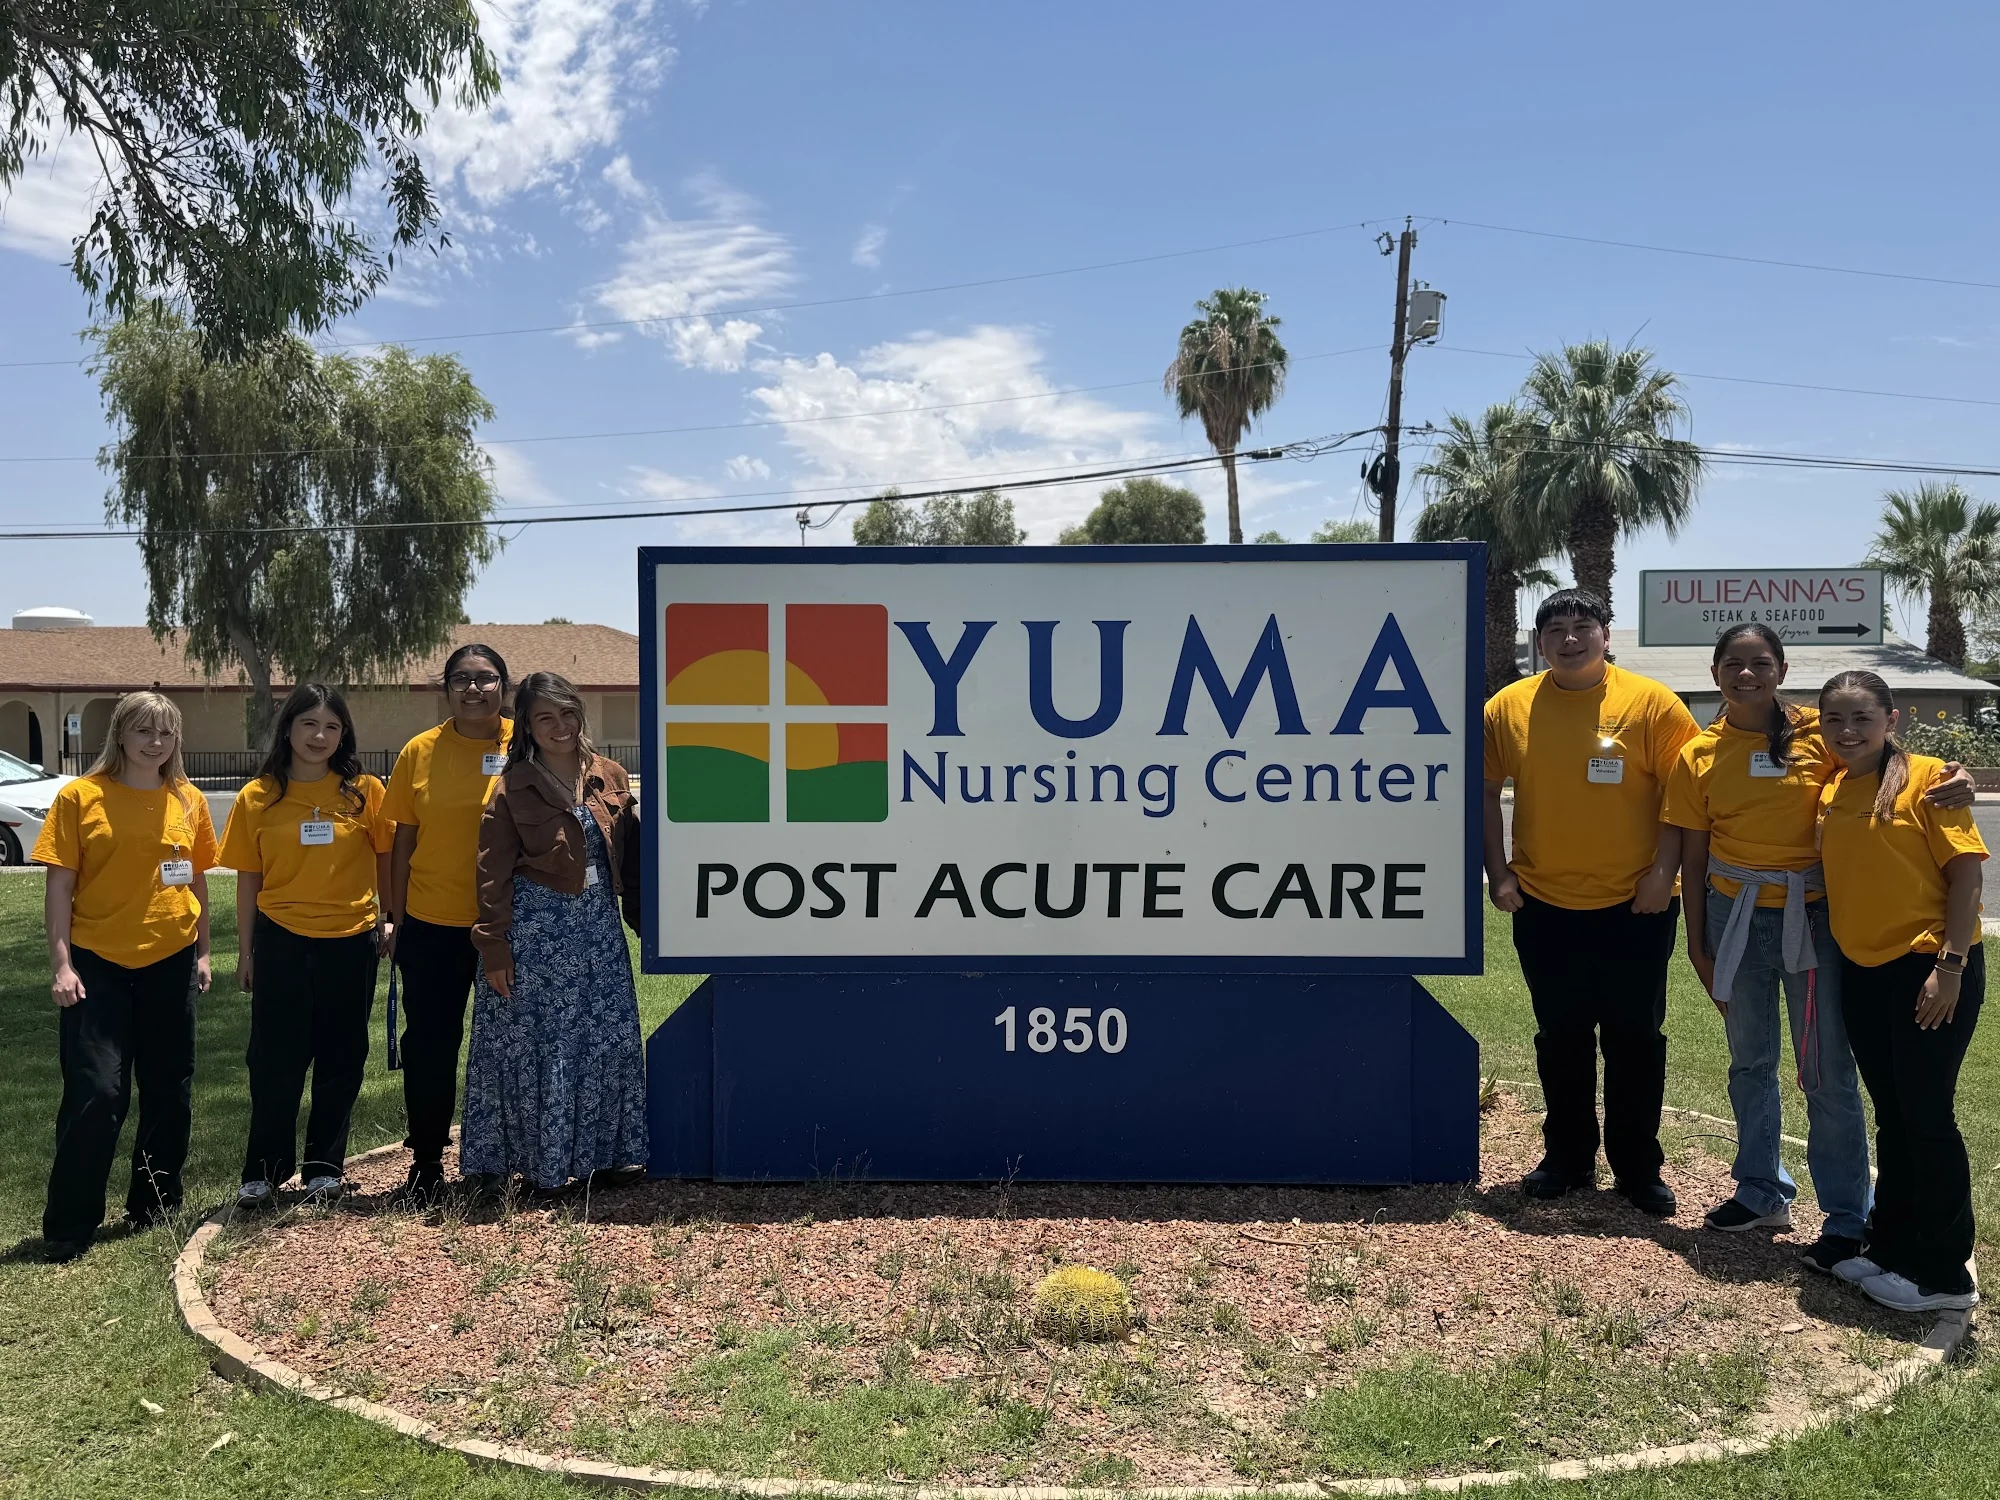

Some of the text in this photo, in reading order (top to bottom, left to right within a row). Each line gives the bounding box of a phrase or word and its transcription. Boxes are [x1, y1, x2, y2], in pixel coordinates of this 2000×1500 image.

[1661, 578, 1866, 604] JULIEANNA'S
[1702, 608, 1825, 622] STEAK & SEAFOOD
[894, 613, 1451, 739] YUMA
[900, 749, 1449, 818] Nursing Center
[695, 861, 1427, 920] POST ACUTE CARE
[994, 1006, 1129, 1054] 1850
